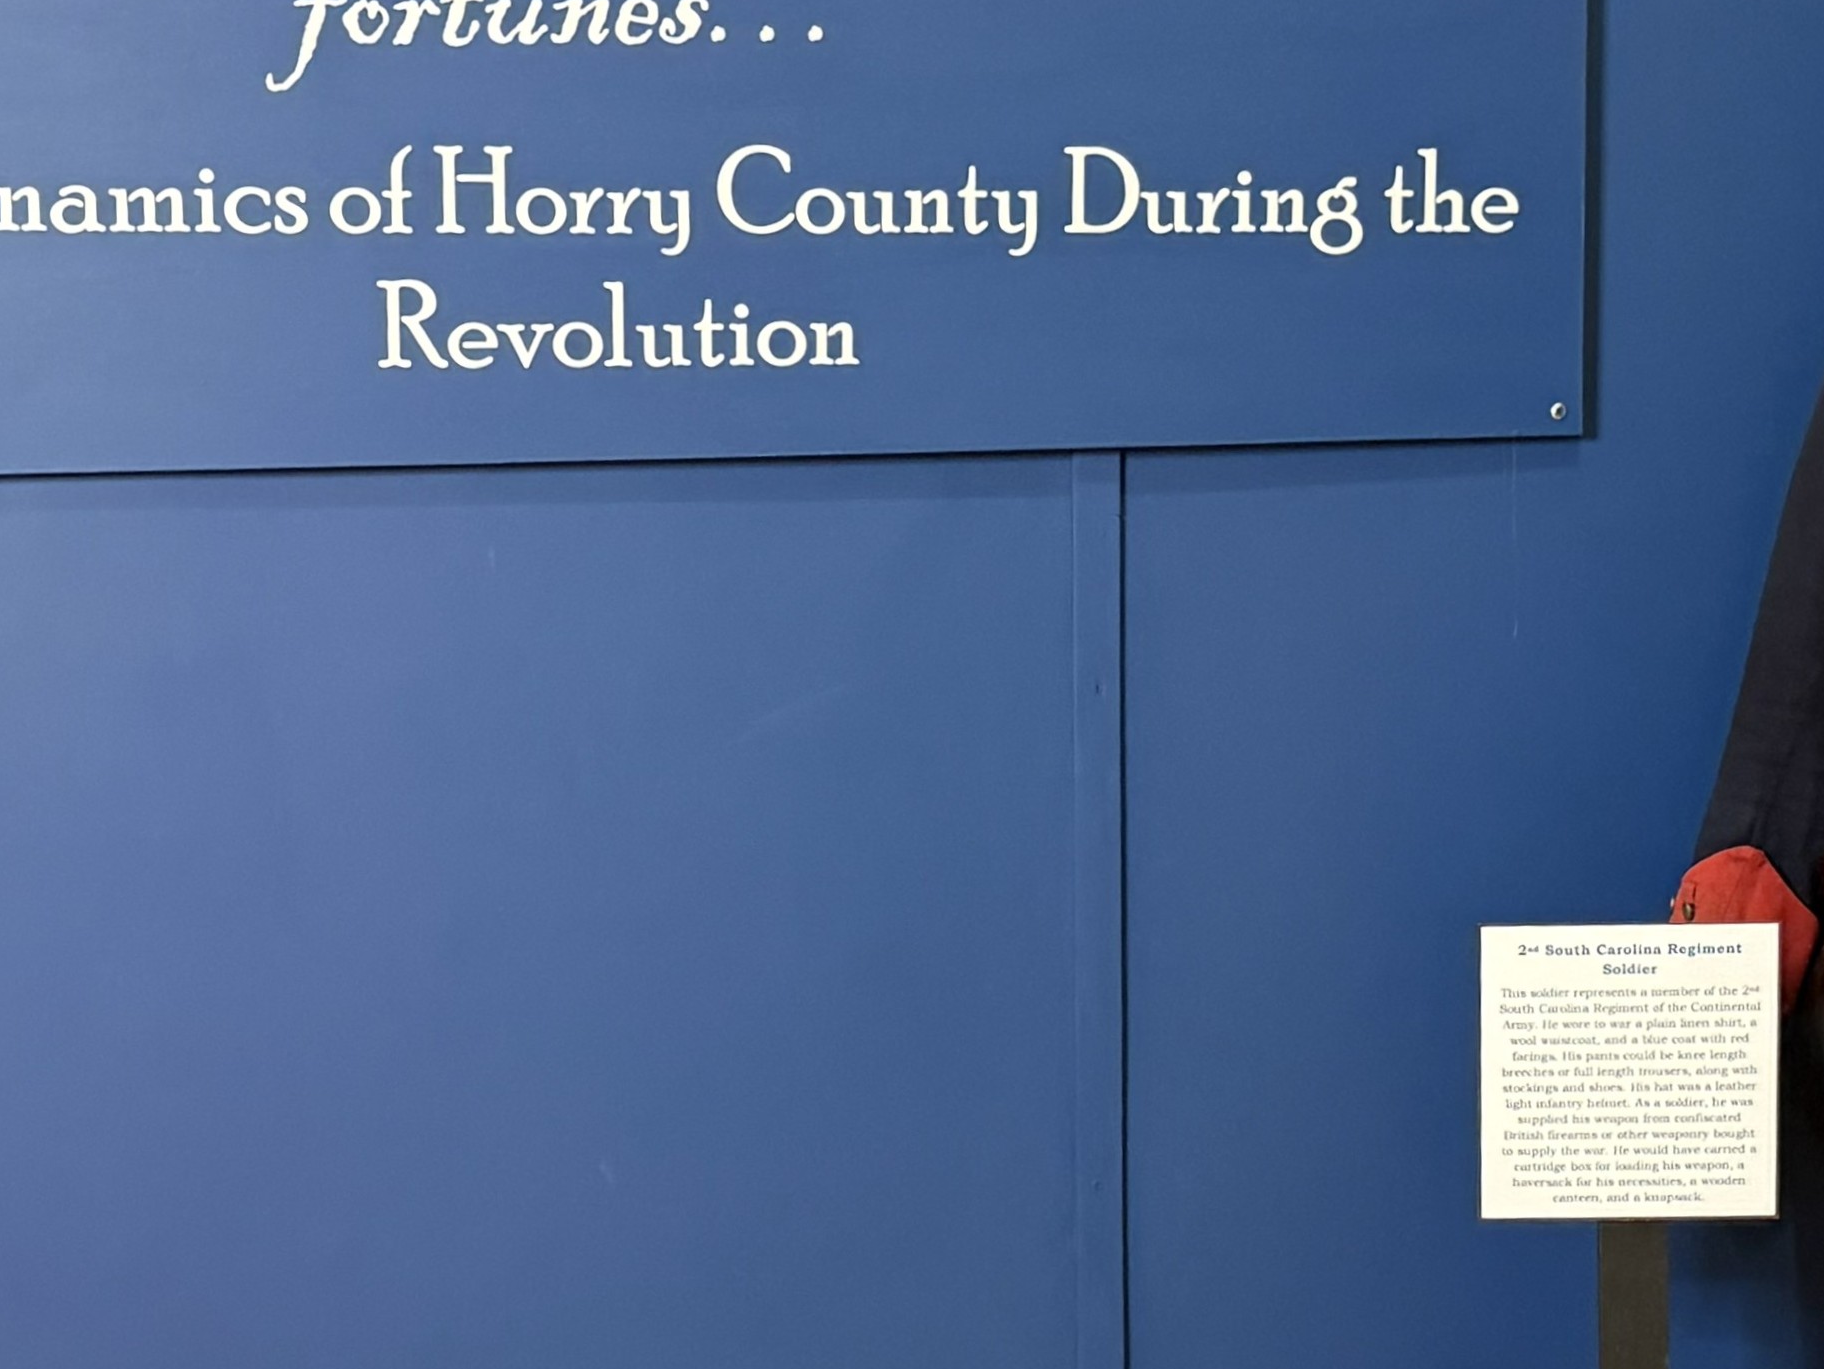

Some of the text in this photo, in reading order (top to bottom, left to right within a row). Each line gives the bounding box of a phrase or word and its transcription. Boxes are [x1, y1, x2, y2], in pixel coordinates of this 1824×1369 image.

[329, 145, 413, 235] of
[433, 145, 690, 256] Horry
[716, 144, 1038, 257] County
[1064, 146, 1363, 255] During
[1384, 148, 1519, 234] the
[376, 279, 860, 369] Revolution
[1544, 943, 1591, 956] South
[1595, 942, 1662, 956] Carolina
[1666, 941, 1742, 958] Regiment
[1601, 961, 1658, 975] Soldier
